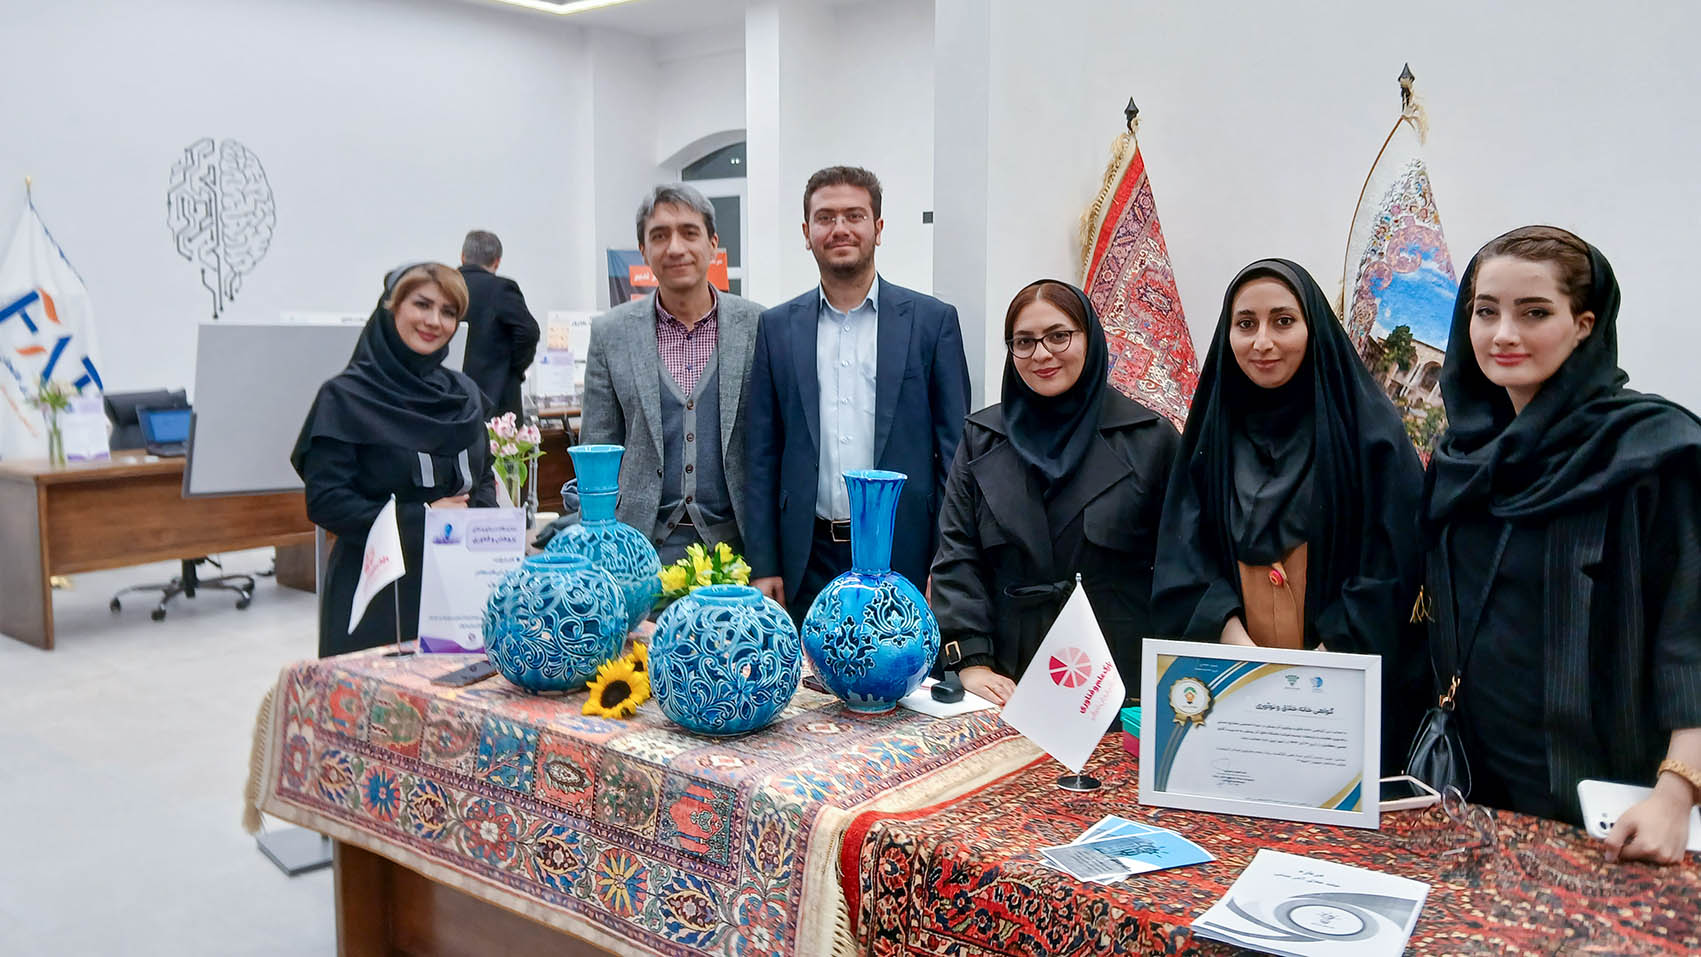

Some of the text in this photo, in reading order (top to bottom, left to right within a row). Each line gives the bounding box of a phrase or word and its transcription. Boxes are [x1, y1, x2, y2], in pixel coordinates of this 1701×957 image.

[1080, 689, 1095, 714] فناوری
[1299, 705, 1312, 713] خانه
[1313, 707, 1334, 715] گواهی
